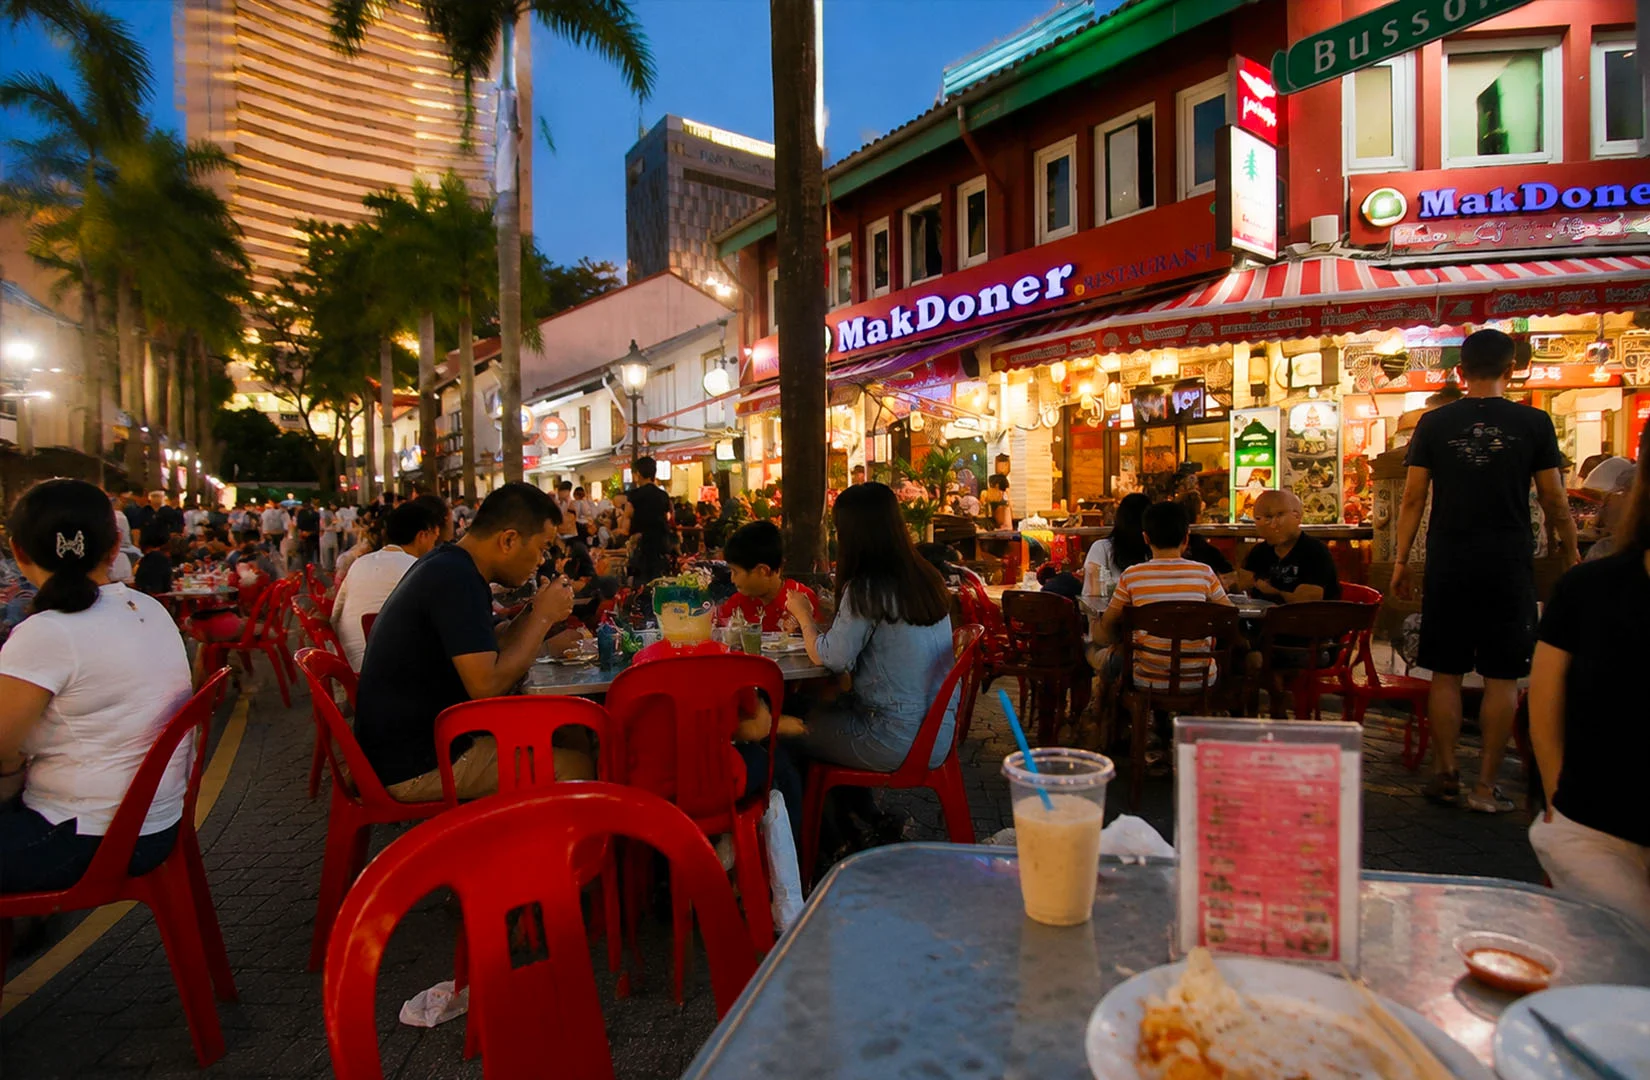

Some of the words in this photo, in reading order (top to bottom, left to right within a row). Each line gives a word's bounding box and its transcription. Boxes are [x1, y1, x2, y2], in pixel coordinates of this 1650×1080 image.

[1420, 182, 1650, 218] MakDone
[838, 263, 1073, 352] MakDoner
[1083, 242, 1213, 290] RESTAURANT
